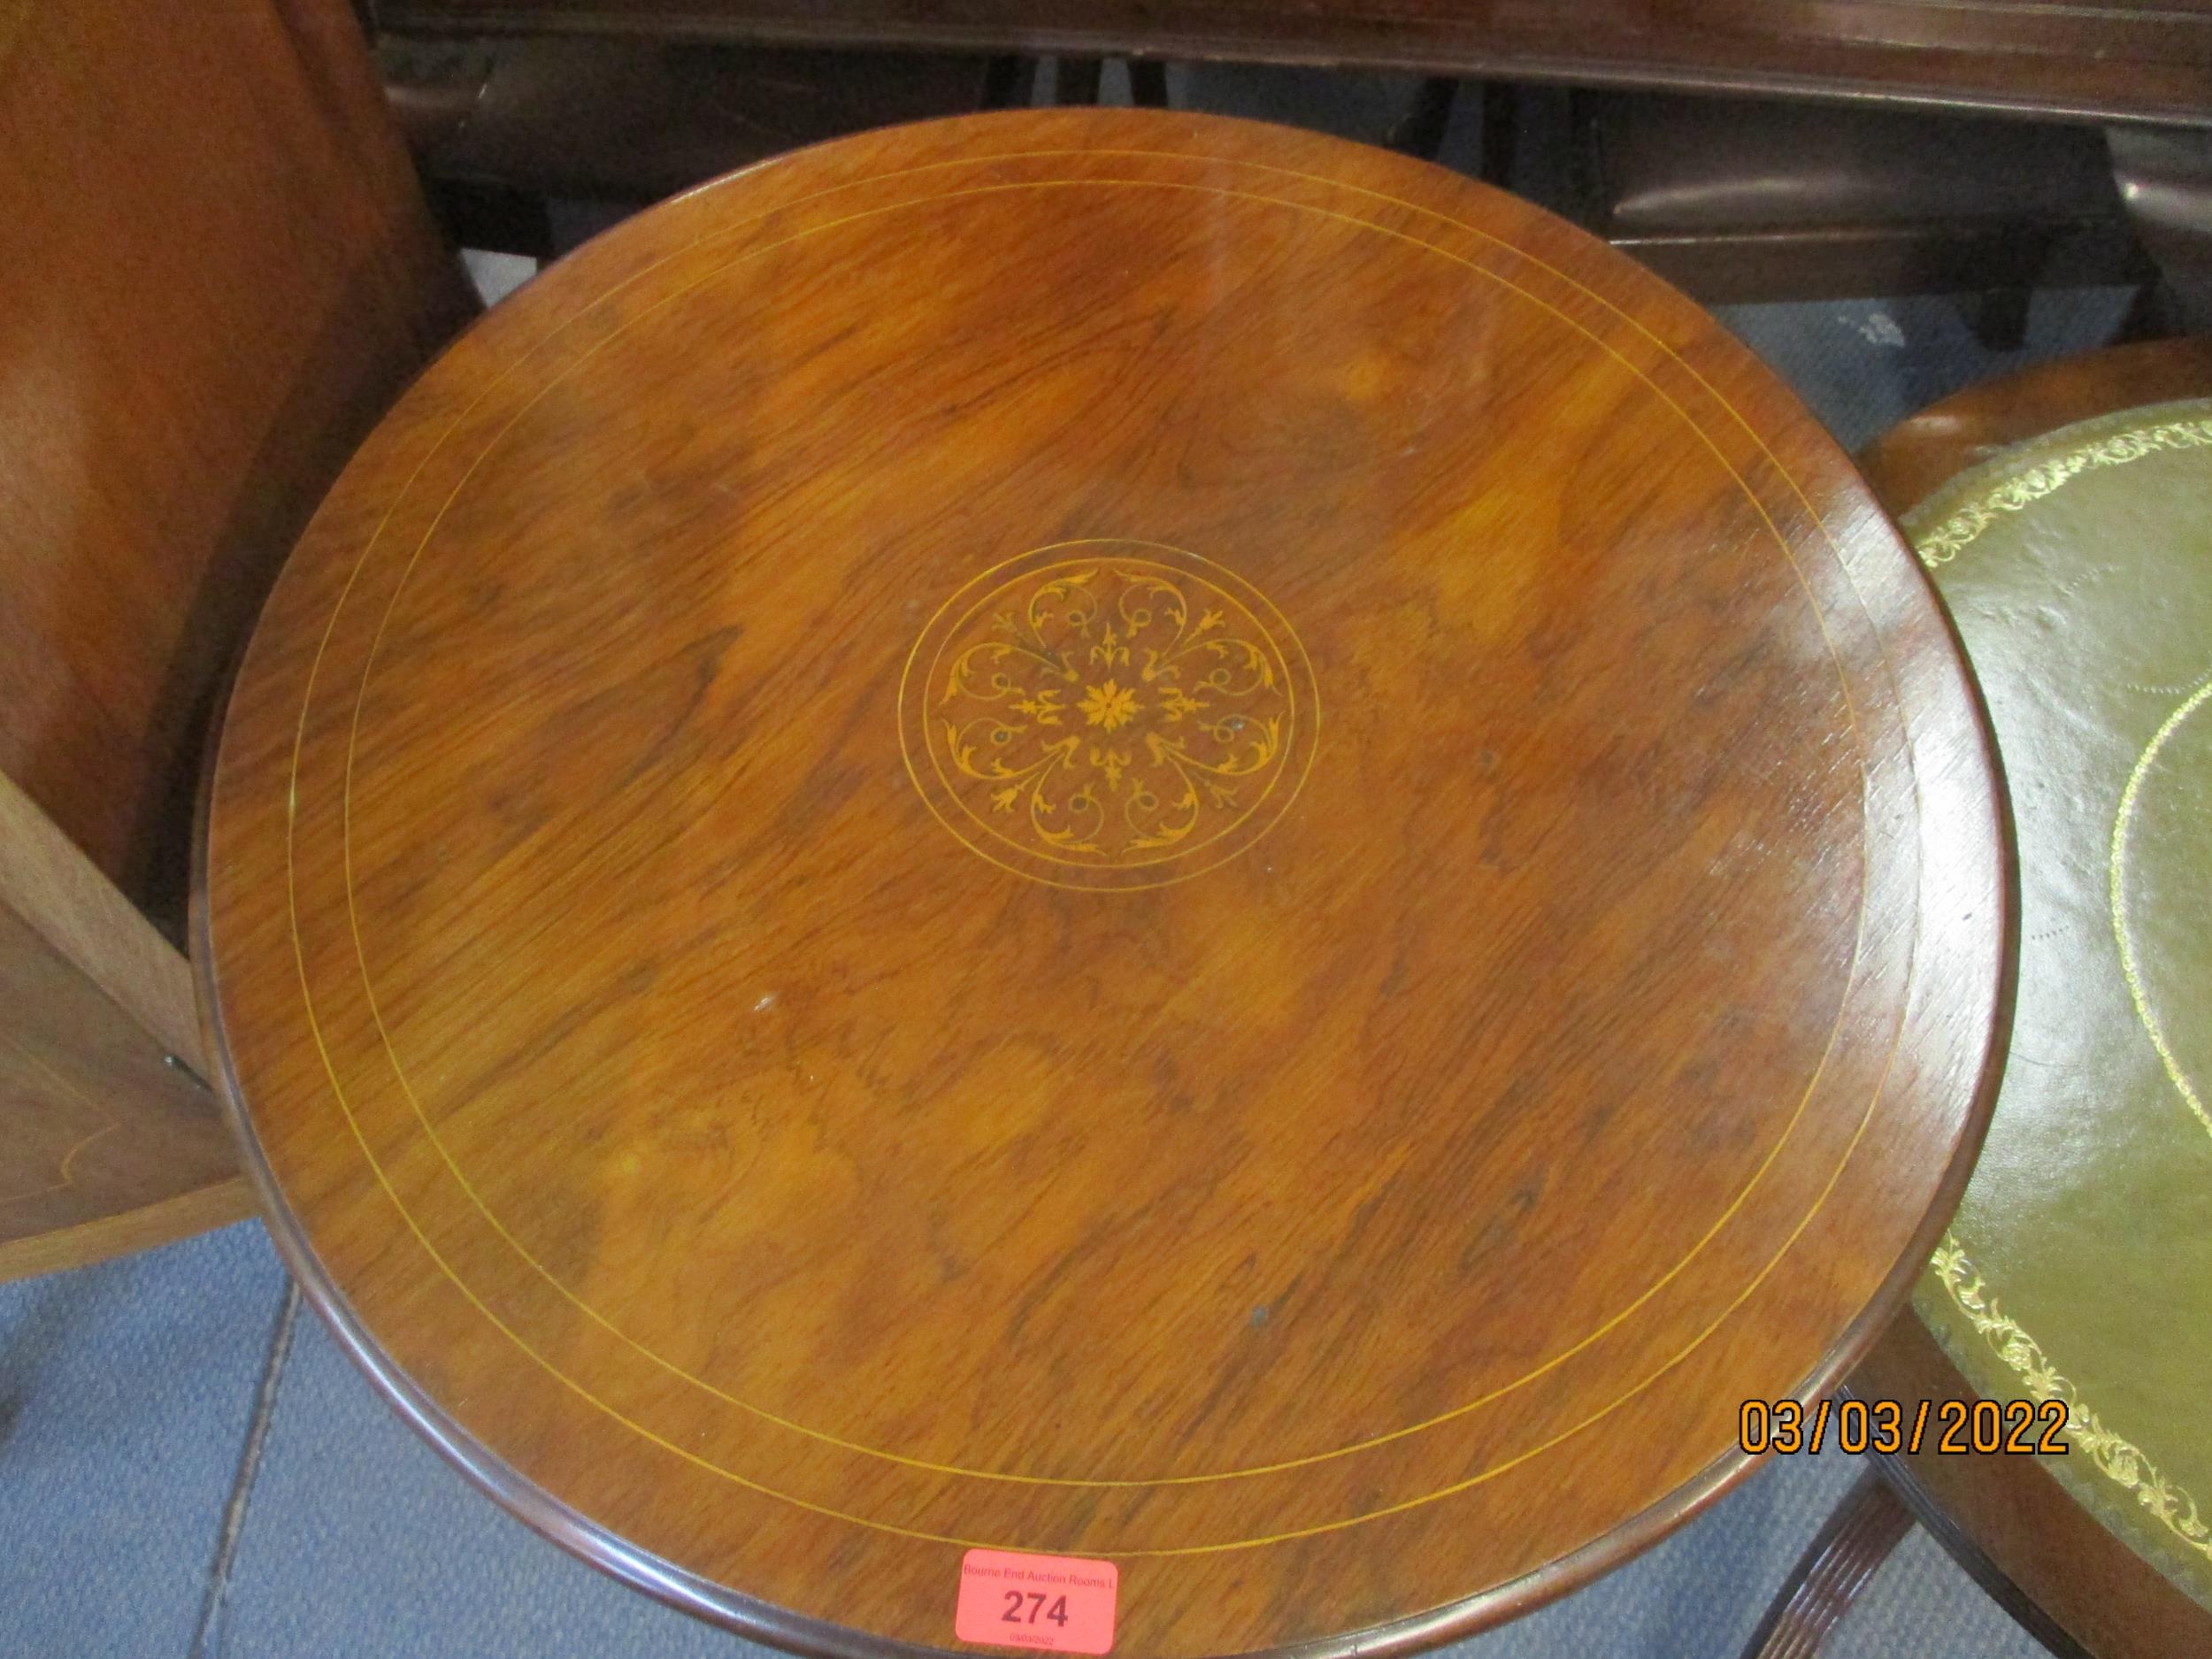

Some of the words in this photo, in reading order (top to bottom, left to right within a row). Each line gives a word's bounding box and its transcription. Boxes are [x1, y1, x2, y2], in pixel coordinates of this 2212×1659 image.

[964, 1563, 1001, 1578] Bourne
[1003, 1567, 1025, 1580] End
[1027, 1571, 1066, 1584] Auction
[1069, 1574, 1106, 1588] Rooms
[1002, 1590, 1069, 1627] 274
